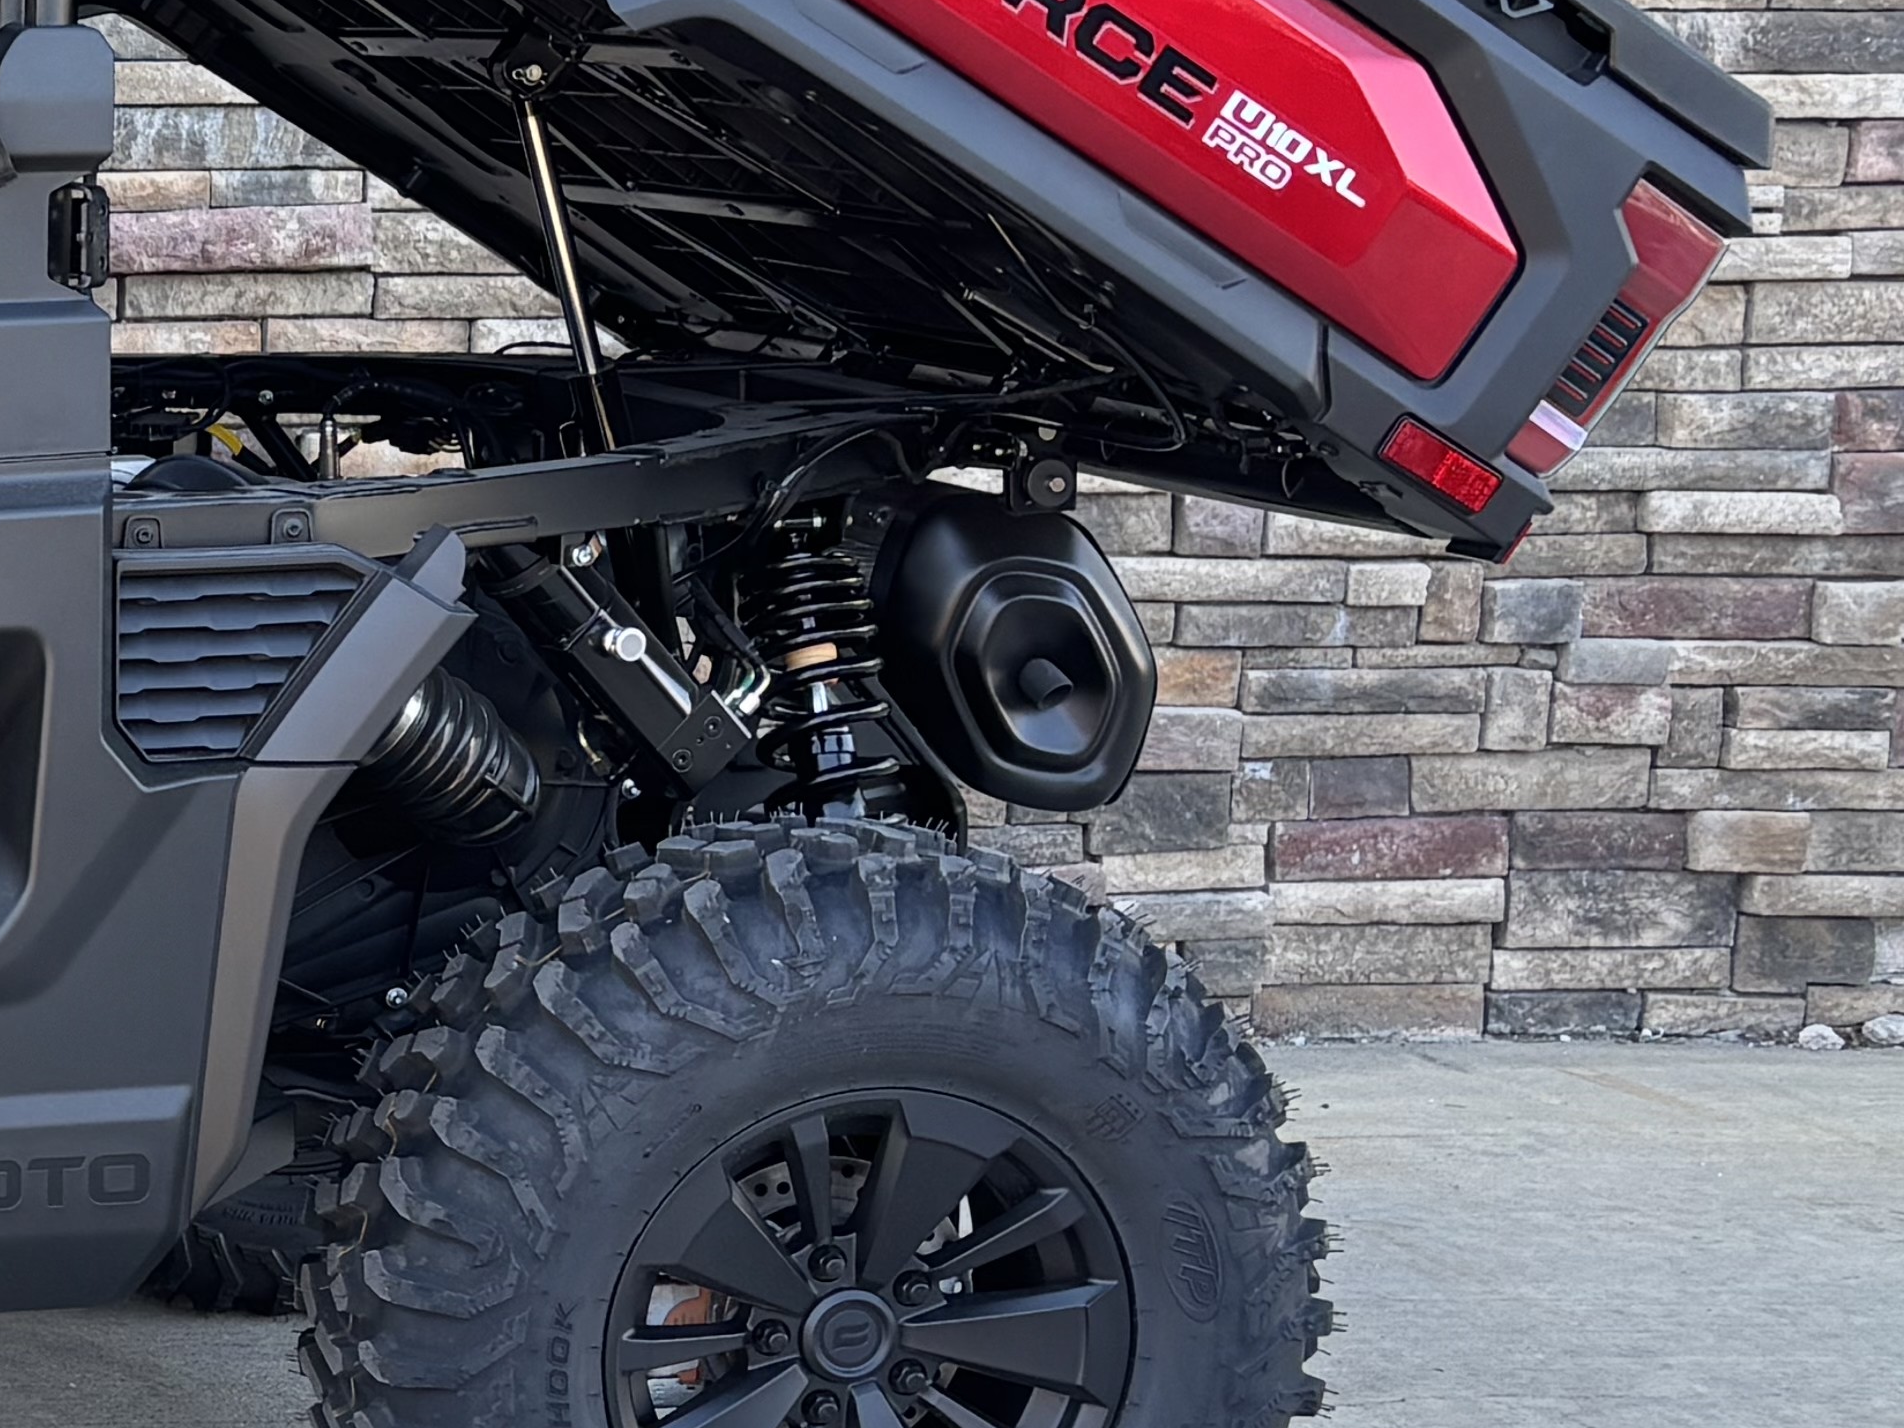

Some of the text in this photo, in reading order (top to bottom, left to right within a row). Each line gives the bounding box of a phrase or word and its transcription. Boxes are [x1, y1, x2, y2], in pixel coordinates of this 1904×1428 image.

[1202, 117, 1293, 190] PRO
[1220, 89, 1366, 208] U10 XL
[1160, 1202, 1219, 1307] ITP
